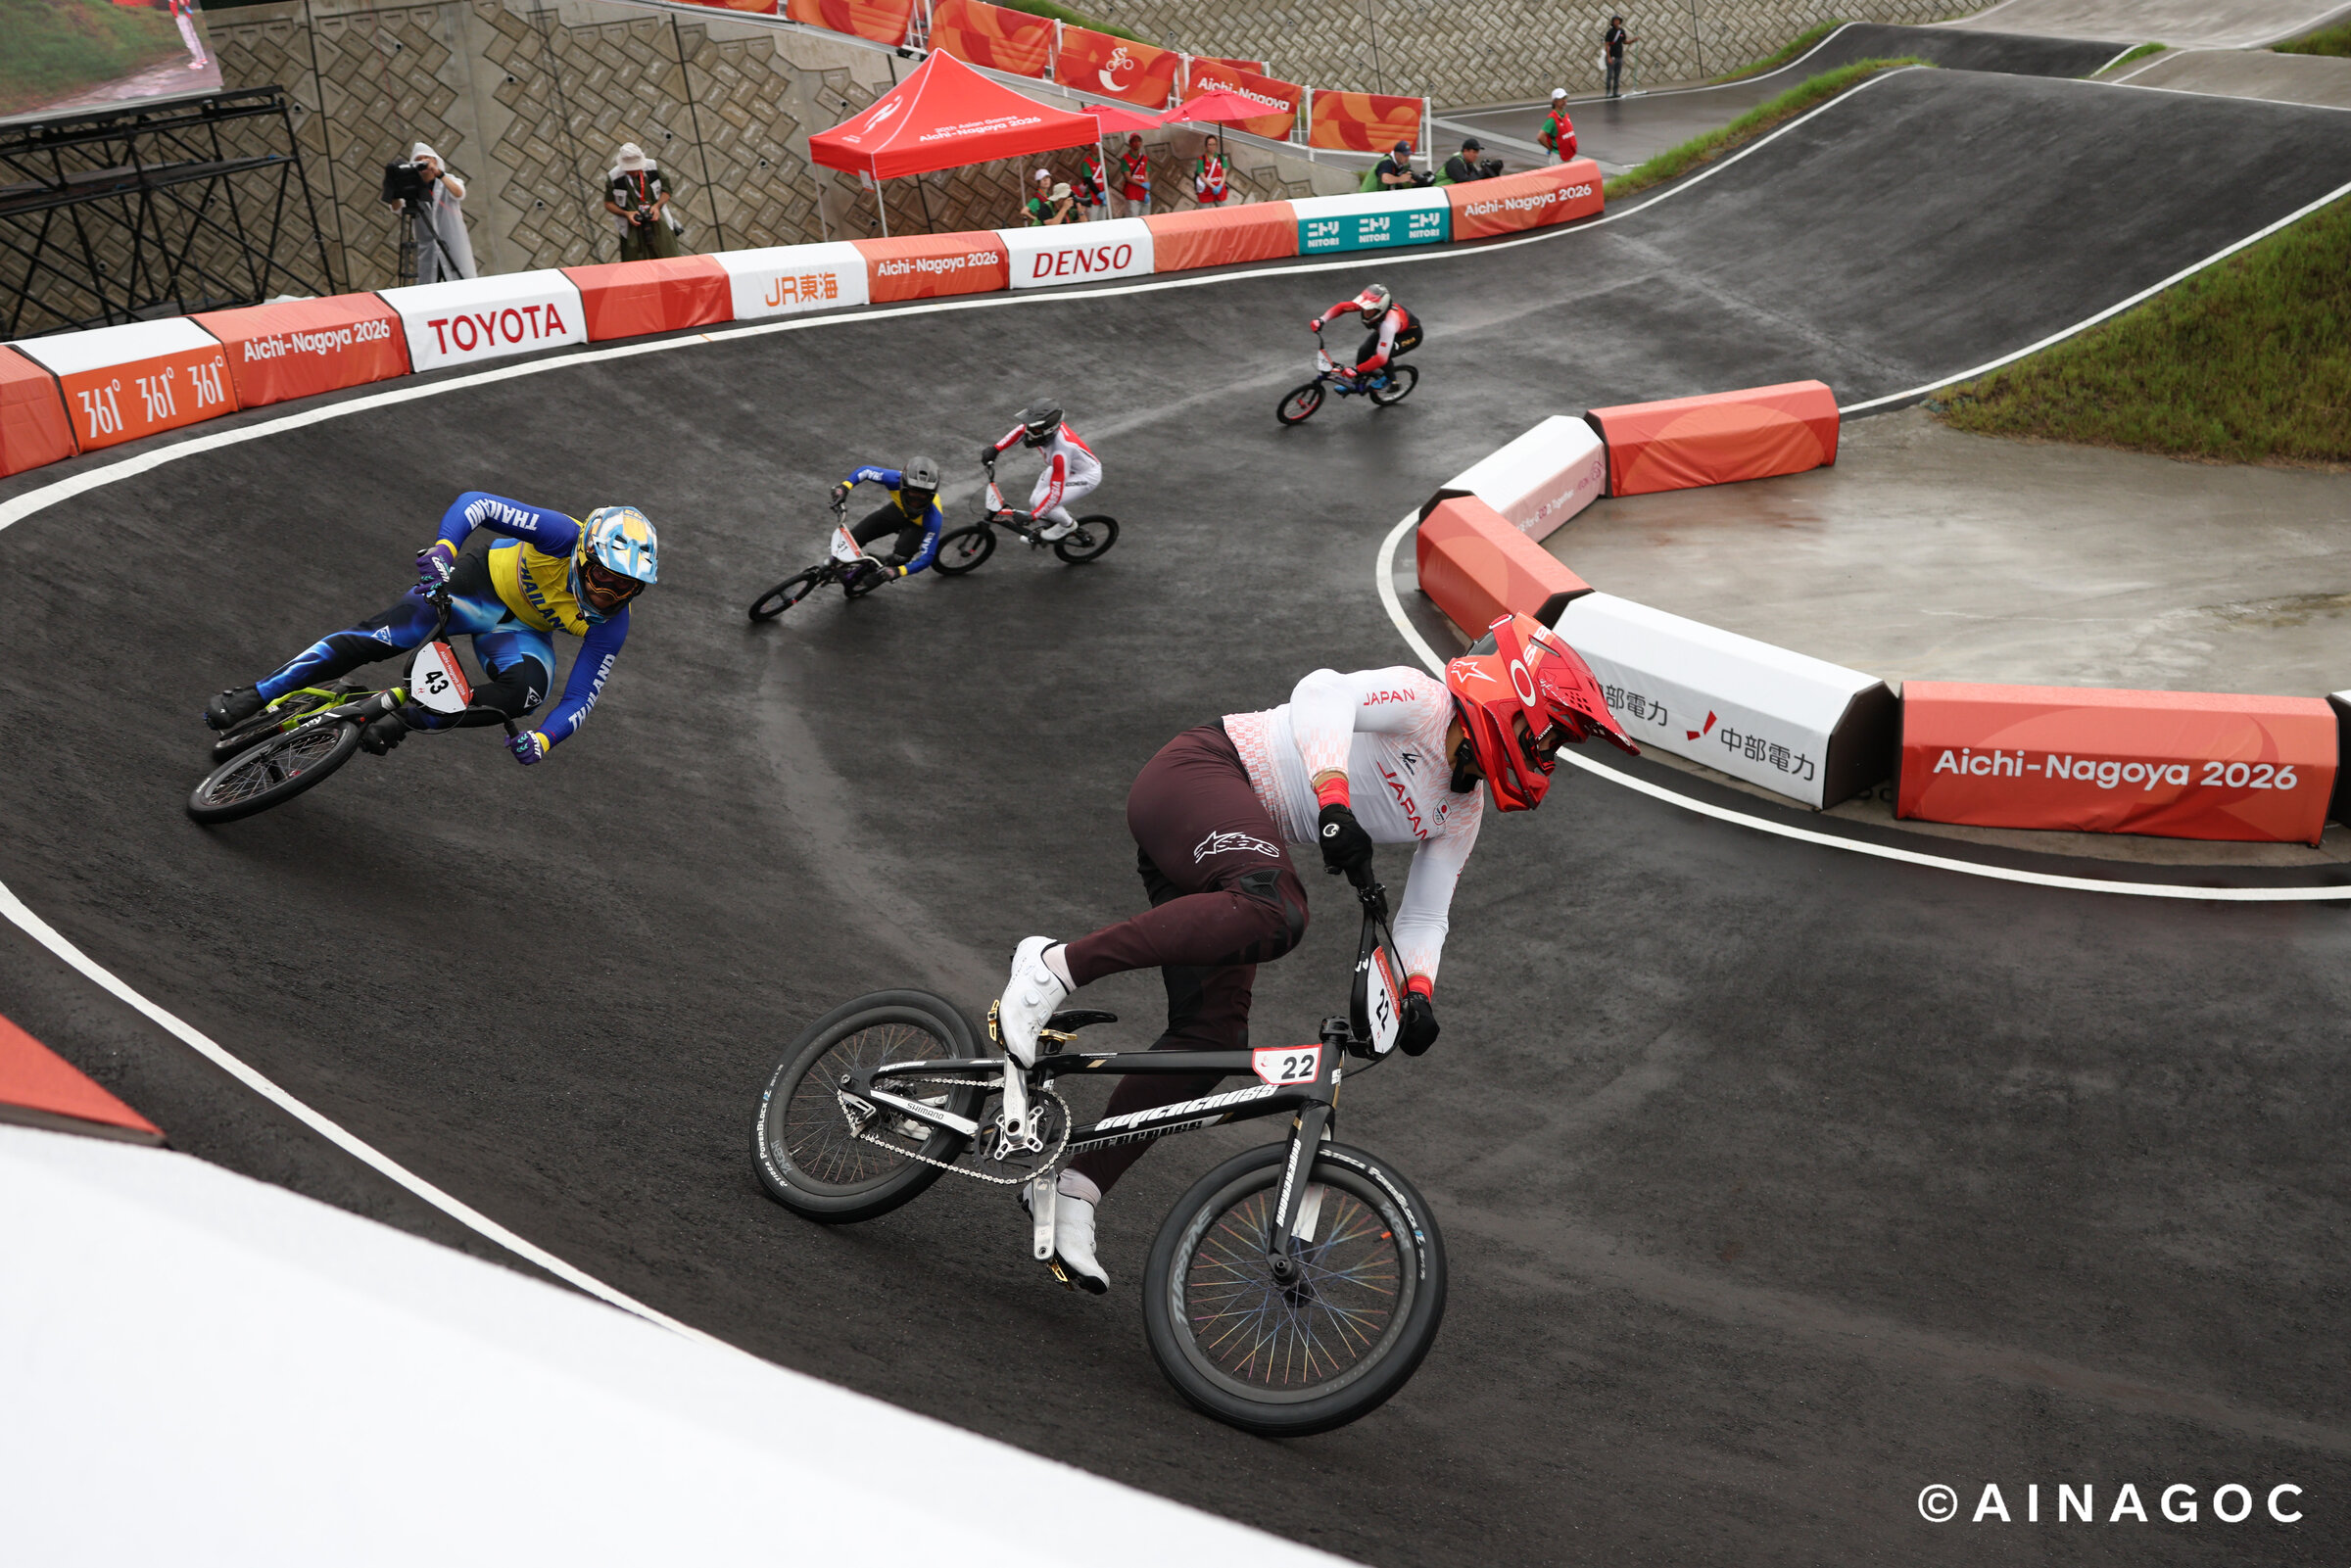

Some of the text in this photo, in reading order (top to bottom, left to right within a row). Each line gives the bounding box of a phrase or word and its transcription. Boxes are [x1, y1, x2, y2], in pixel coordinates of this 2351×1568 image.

[920, 117, 1041, 141] Aichi-Nagoya 2026
[1464, 183, 1592, 217] Aichi-Nagoya 2026
[1308, 221, 1339, 237] ニトリ
[1359, 217, 1390, 233] ニトリ
[1409, 228, 1440, 238] NITORI
[1410, 213, 1440, 228] ニトリ
[1308, 238, 1339, 248] NITORI
[1359, 233, 1390, 243] NITORI
[877, 252, 998, 276] Aichi-Nagoya 2026
[1032, 244, 1132, 278] DENSO
[765, 272, 839, 307] JR東海
[243, 319, 390, 363] Aichi-Nagoya 2026
[427, 303, 567, 355] TOYOTA
[464, 499, 540, 532] THAILAND
[521, 556, 570, 634] THAILAN
[425, 671, 450, 694] 43
[1364, 689, 1415, 706] JAPAN
[1599, 684, 1668, 727] 部電力
[1720, 727, 1815, 783] 中部電力
[1933, 748, 2298, 791] Aichi-Nagoya 2026
[1376, 988, 1389, 1032] 22
[1281, 1055, 1315, 1079] 22
[907, 1103, 944, 1120] SHIMANO
[771, 1140, 792, 1175] TANGENT
